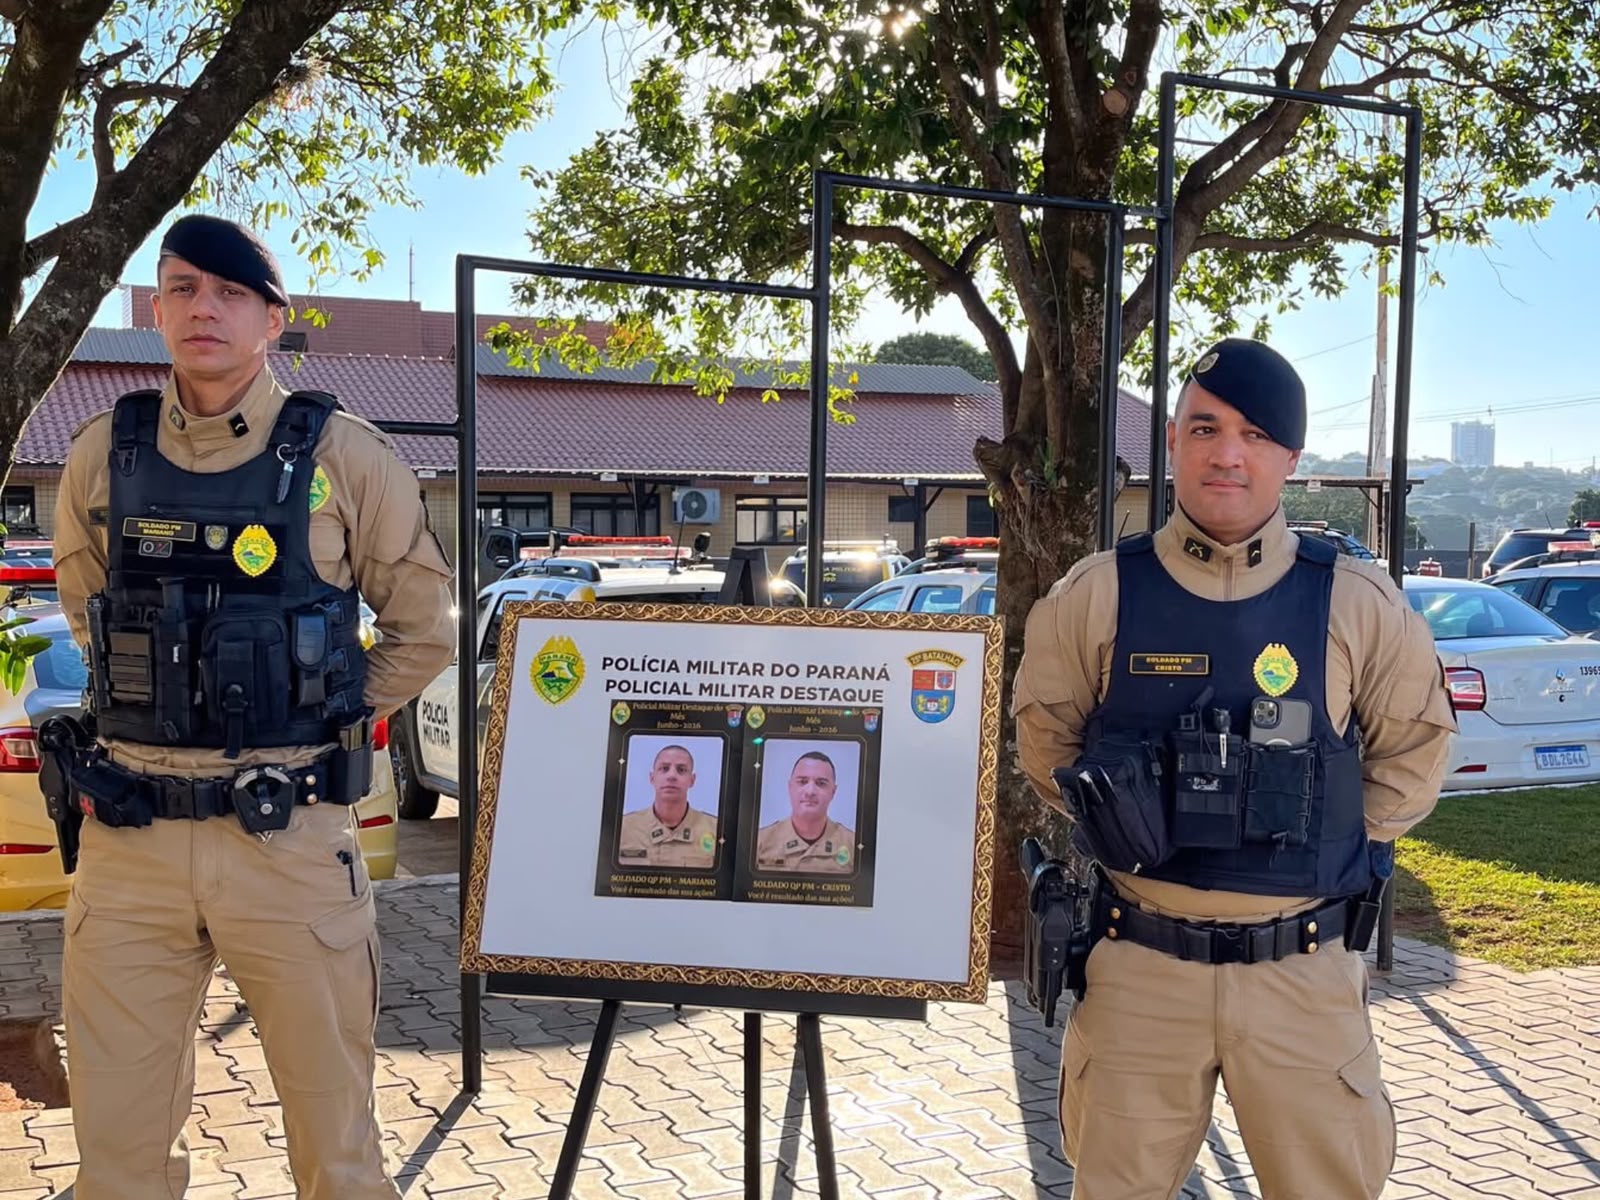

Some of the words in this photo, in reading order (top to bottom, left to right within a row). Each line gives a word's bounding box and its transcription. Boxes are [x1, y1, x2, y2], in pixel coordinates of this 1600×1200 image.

[138, 522, 169, 530] SOLDADO
[143, 528, 174, 536] MARIANO
[602, 655, 680, 673] POLÍCIA
[686, 660, 765, 677] MILITAR
[771, 663, 800, 678] DO
[806, 663, 890, 681] PARANÁ
[605, 679, 692, 696] POLICIAL
[699, 683, 774, 699] MILITAR
[780, 686, 884, 703] DESTAQUE
[633, 702, 657, 710] Policial
[658, 702, 681, 711] Militar
[682, 703, 713, 712] Destaque
[423, 723, 452, 750] MILITAR
[611, 875, 647, 883] SOLDADO
[752, 880, 789, 889] SOLDADO
